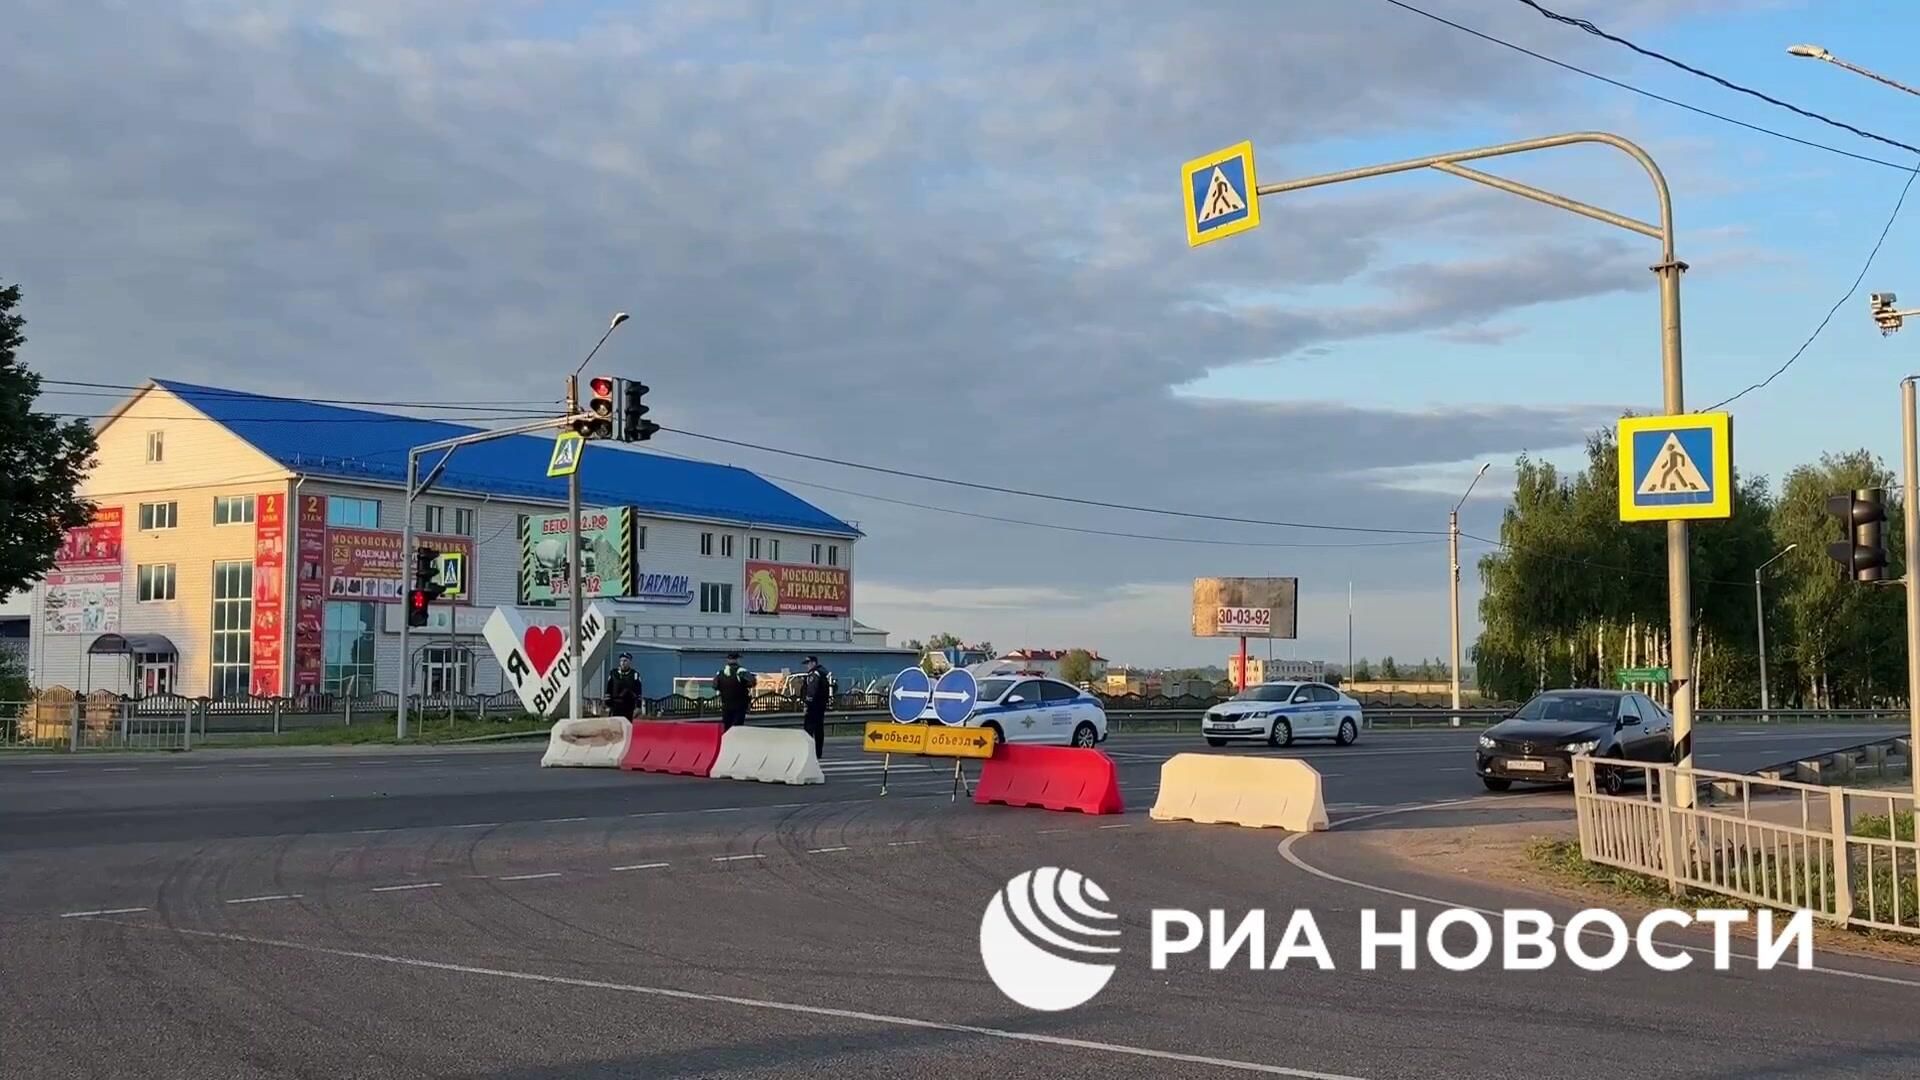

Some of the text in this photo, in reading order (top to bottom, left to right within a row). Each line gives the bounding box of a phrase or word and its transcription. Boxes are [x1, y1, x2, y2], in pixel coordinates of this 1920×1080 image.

[266, 495, 275, 513] 2
[308, 496, 318, 512] 2
[543, 515, 608, 532] БЕТО2.РФ
[787, 582, 839, 600] ЯРМАРКА
[1218, 608, 1270, 625] 30-03-92
[507, 613, 600, 713] Я ВЫГОЧИ
[883, 730, 921, 745] объезд
[931, 733, 971, 746] объезд
